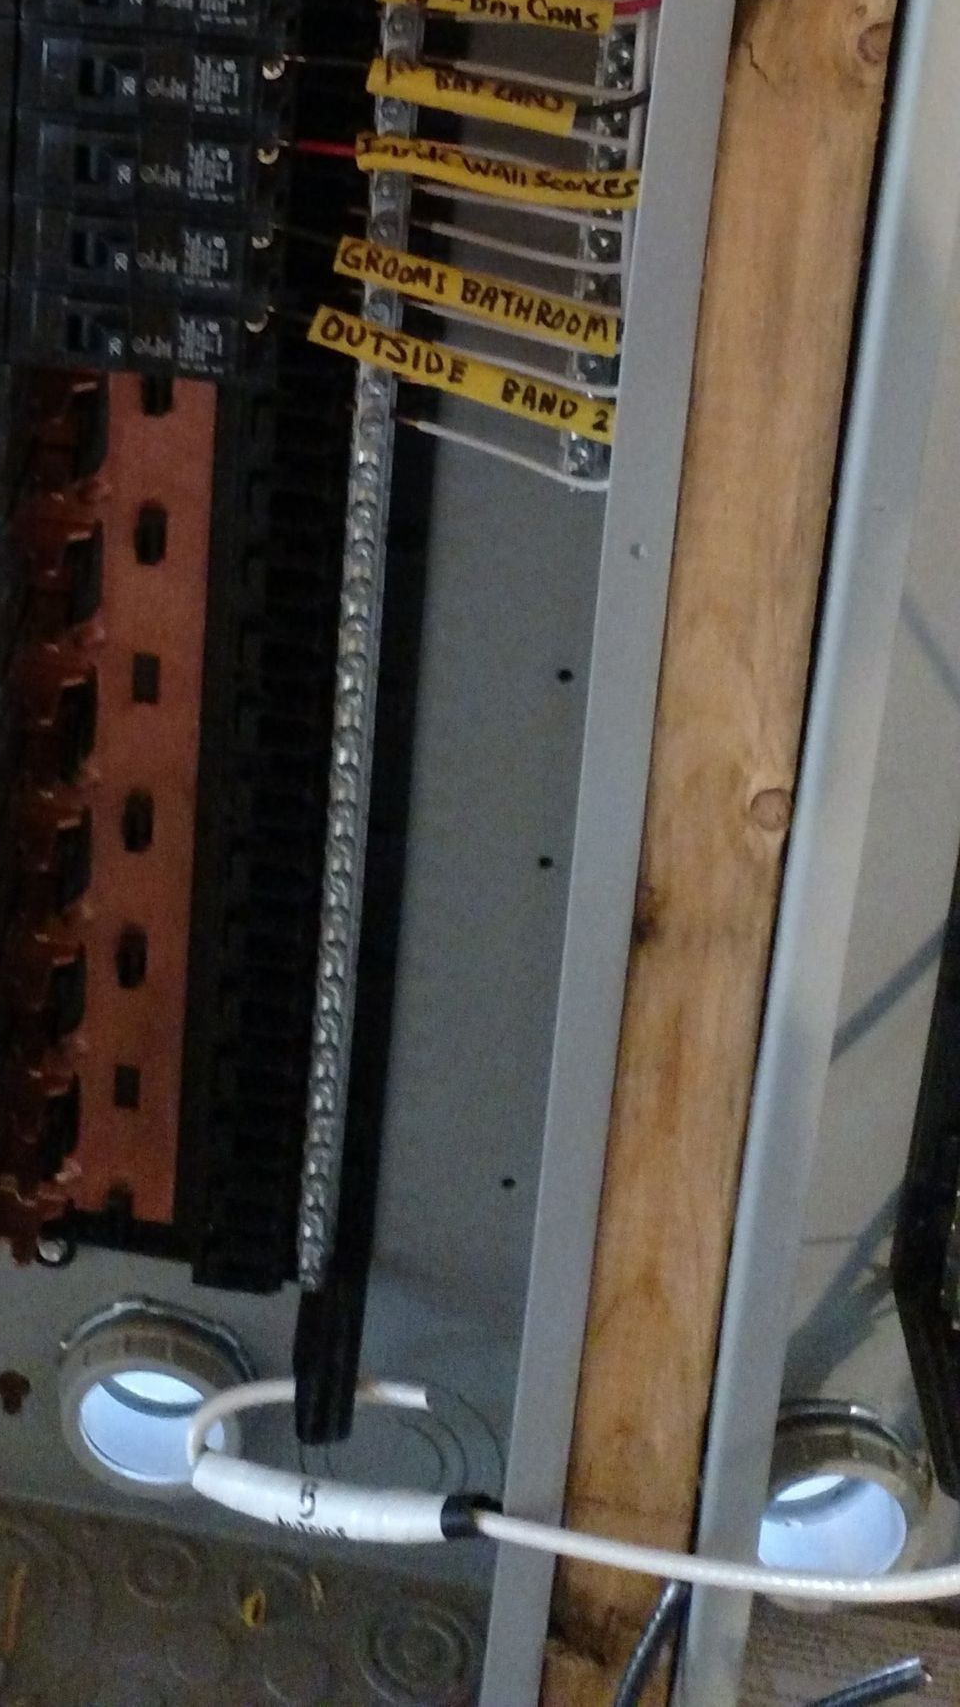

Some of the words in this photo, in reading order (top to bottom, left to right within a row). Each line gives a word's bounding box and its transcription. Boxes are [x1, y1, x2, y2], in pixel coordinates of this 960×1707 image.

[340, 242, 448, 295] GROOMS
[461, 276, 609, 344] BATHROOM
[320, 312, 470, 385] OUTSIDE
[501, 377, 579, 421] BAND
[590, 409, 610, 434] 2
